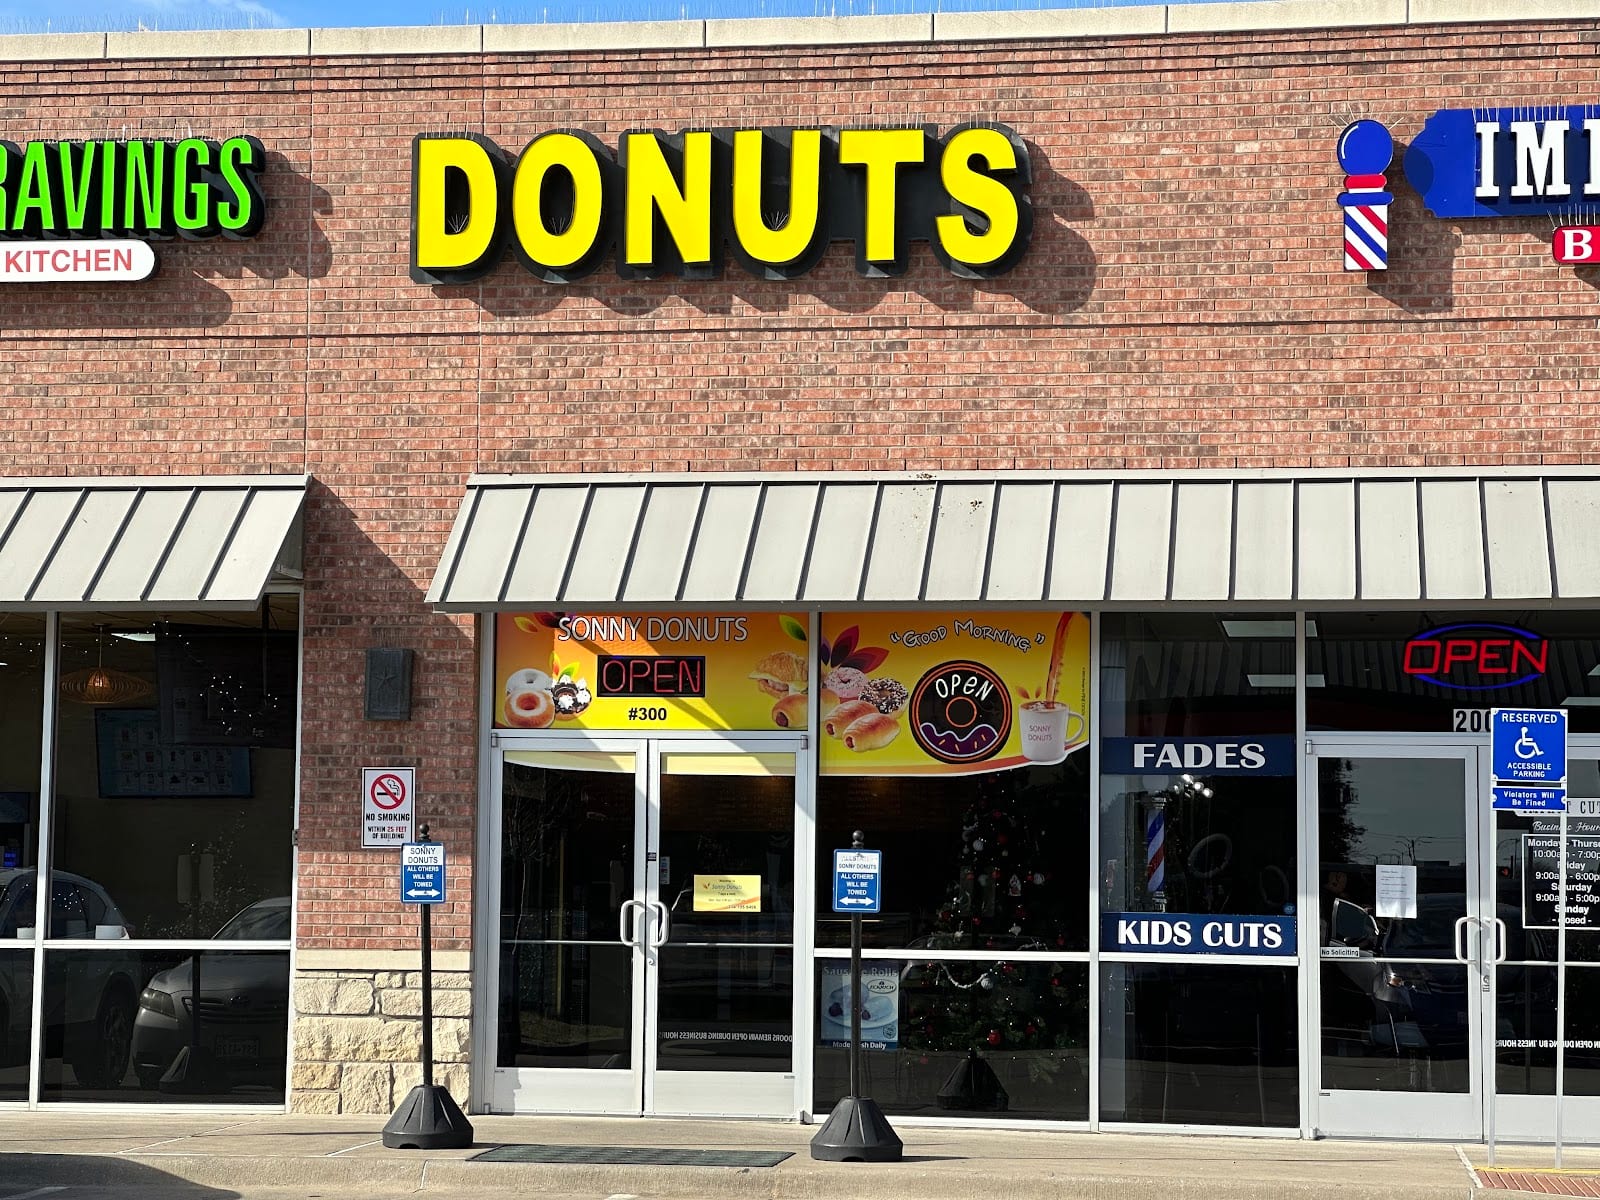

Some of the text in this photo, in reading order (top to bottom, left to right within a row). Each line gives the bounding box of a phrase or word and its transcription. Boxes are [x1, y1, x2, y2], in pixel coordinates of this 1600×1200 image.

[0, 138, 252, 229] AVINGS
[417, 128, 1018, 268] DONUTS
[6, 249, 132, 272] KITCHEN
[558, 616, 747, 641] SONNY DONUTS
[1403, 640, 1548, 674] OPEN
[602, 660, 701, 692] OPEN
[628, 707, 667, 721] #300
[1502, 713, 1557, 723] RESERVED
[1134, 744, 1265, 768] FADES
[1507, 762, 1551, 770] ACCESSIBLE
[1503, 790, 1555, 799] Violators Will
[366, 813, 410, 821] NO SMOKING
[1532, 821, 1572, 831] Busins
[1528, 839, 1560, 848] Monda
[1557, 861, 1586, 871] Fiday
[1535, 872, 1567, 880] 9:00a
[1551, 883, 1592, 893] Surday
[1535, 894, 1567, 902] 9:00a
[1554, 904, 1589, 915] Snday
[1558, 916, 1586, 924] osed
[1118, 920, 1282, 948] KIDS CUTS
[823, 967, 867, 976] Sause
[870, 1042, 887, 1050] Daily
